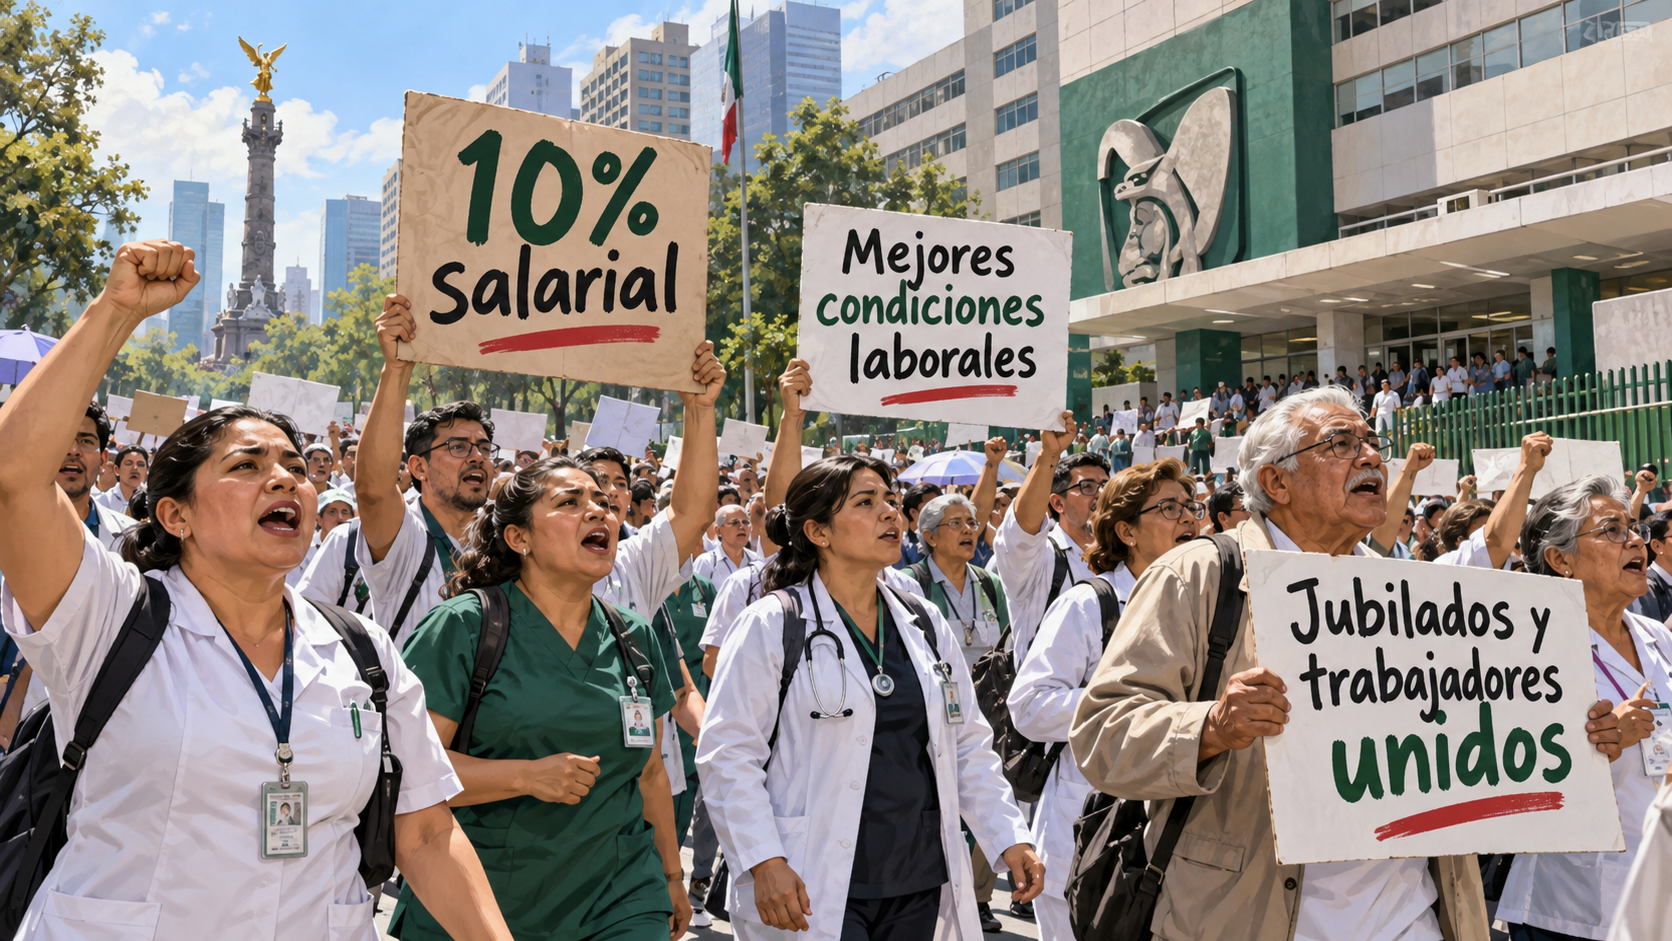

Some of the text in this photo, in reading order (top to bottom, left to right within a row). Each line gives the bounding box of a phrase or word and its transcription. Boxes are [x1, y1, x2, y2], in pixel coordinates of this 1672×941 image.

[457, 130, 659, 247] 10%
[842, 227, 1015, 292] Mejores
[816, 279, 1045, 327] condiciones
[849, 331, 1037, 385] laborales
[1286, 576, 1551, 655] Jubilados y
[1298, 646, 1564, 725] trabajadores
[1331, 700, 1573, 804] unidos
